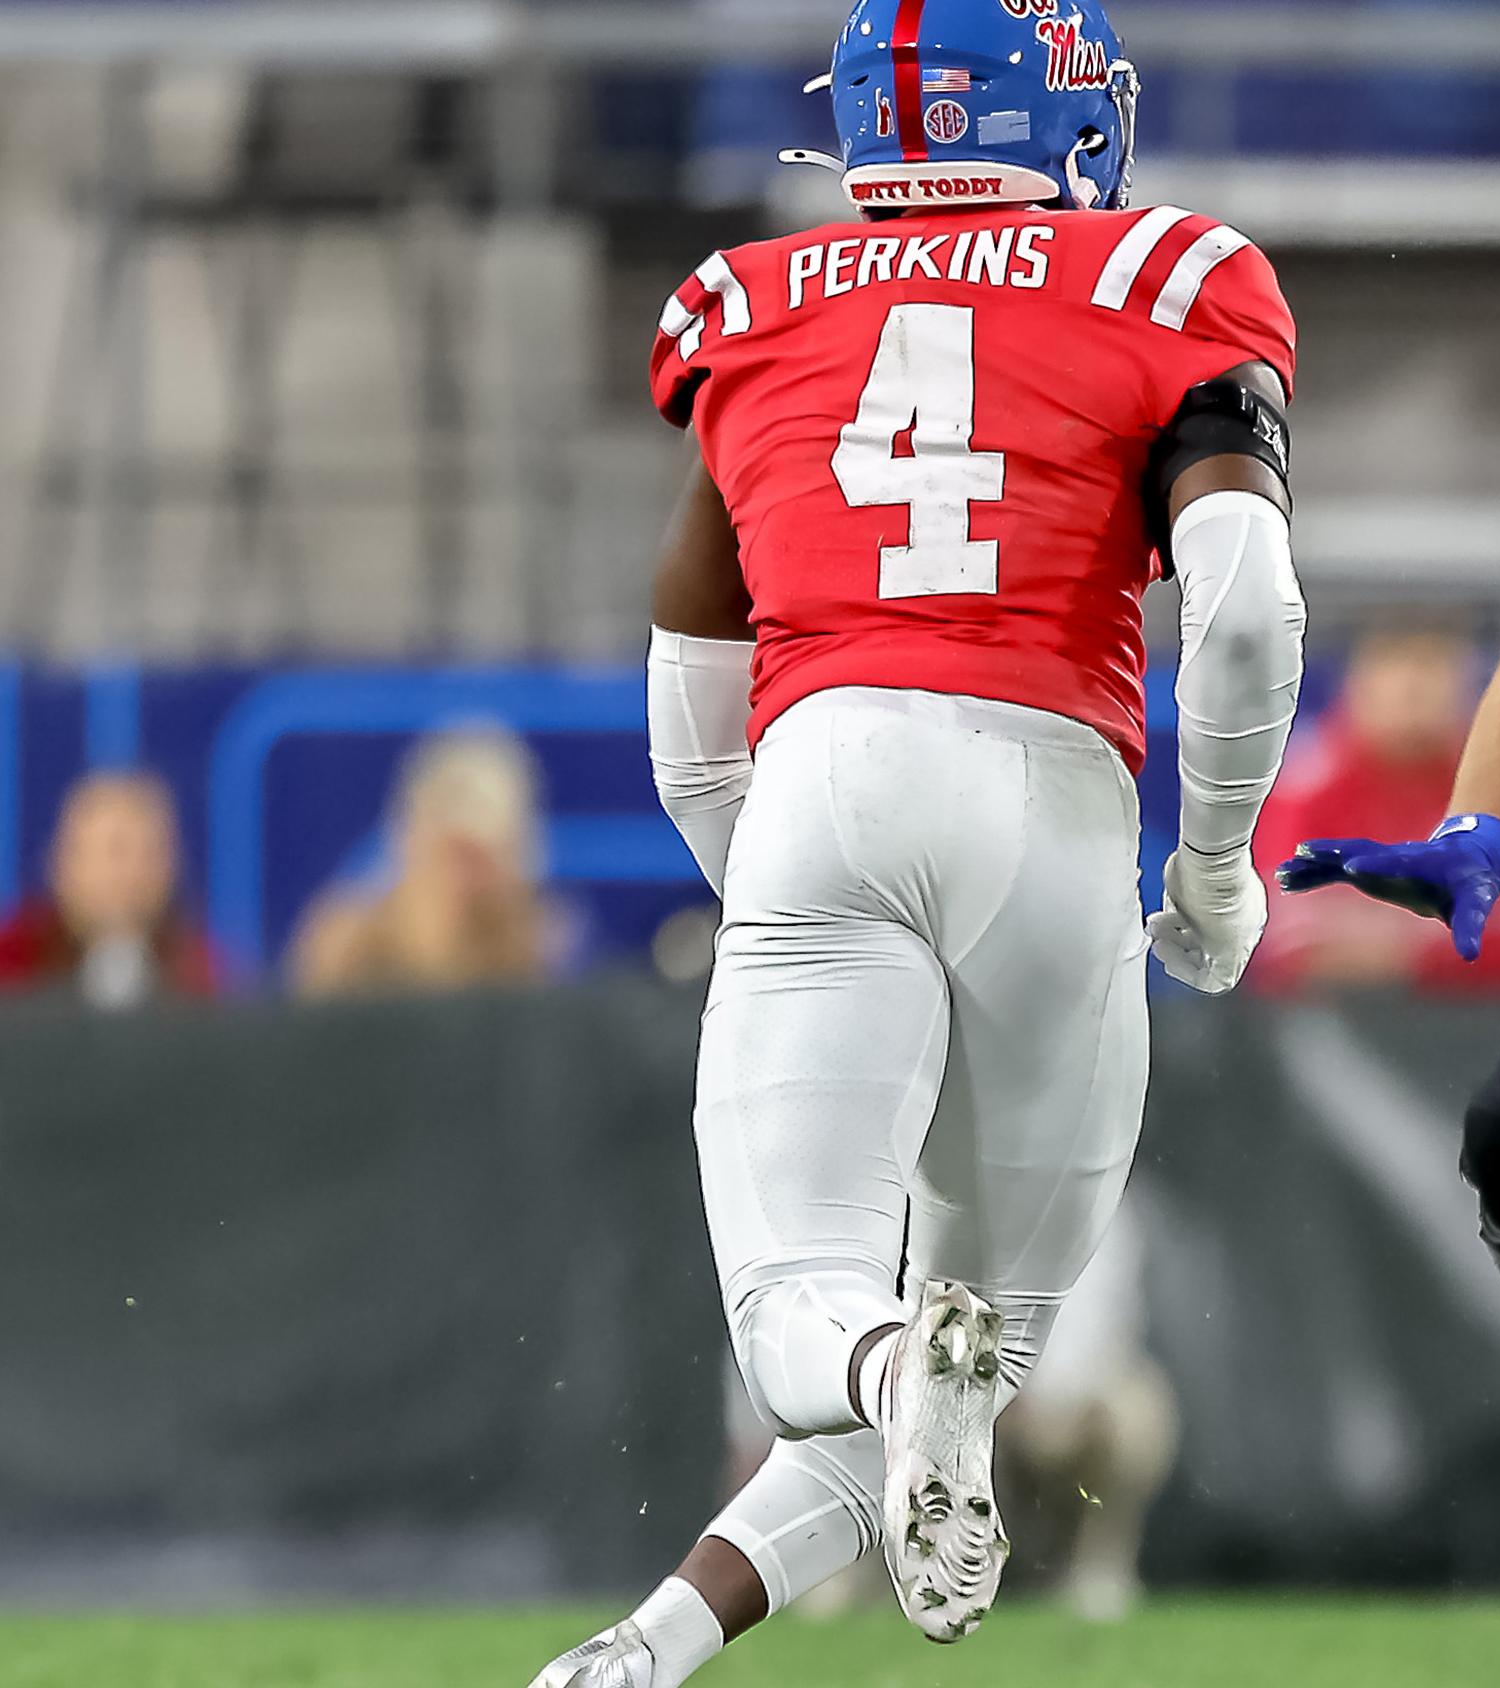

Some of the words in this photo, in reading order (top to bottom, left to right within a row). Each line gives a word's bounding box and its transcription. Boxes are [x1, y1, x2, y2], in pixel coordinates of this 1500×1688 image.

[1037, 19, 1107, 90] Miss
[928, 103, 964, 139] SEC
[918, 178, 1002, 197] TODDY
[788, 225, 1055, 310] PERKINS
[830, 302, 1004, 599] 4
